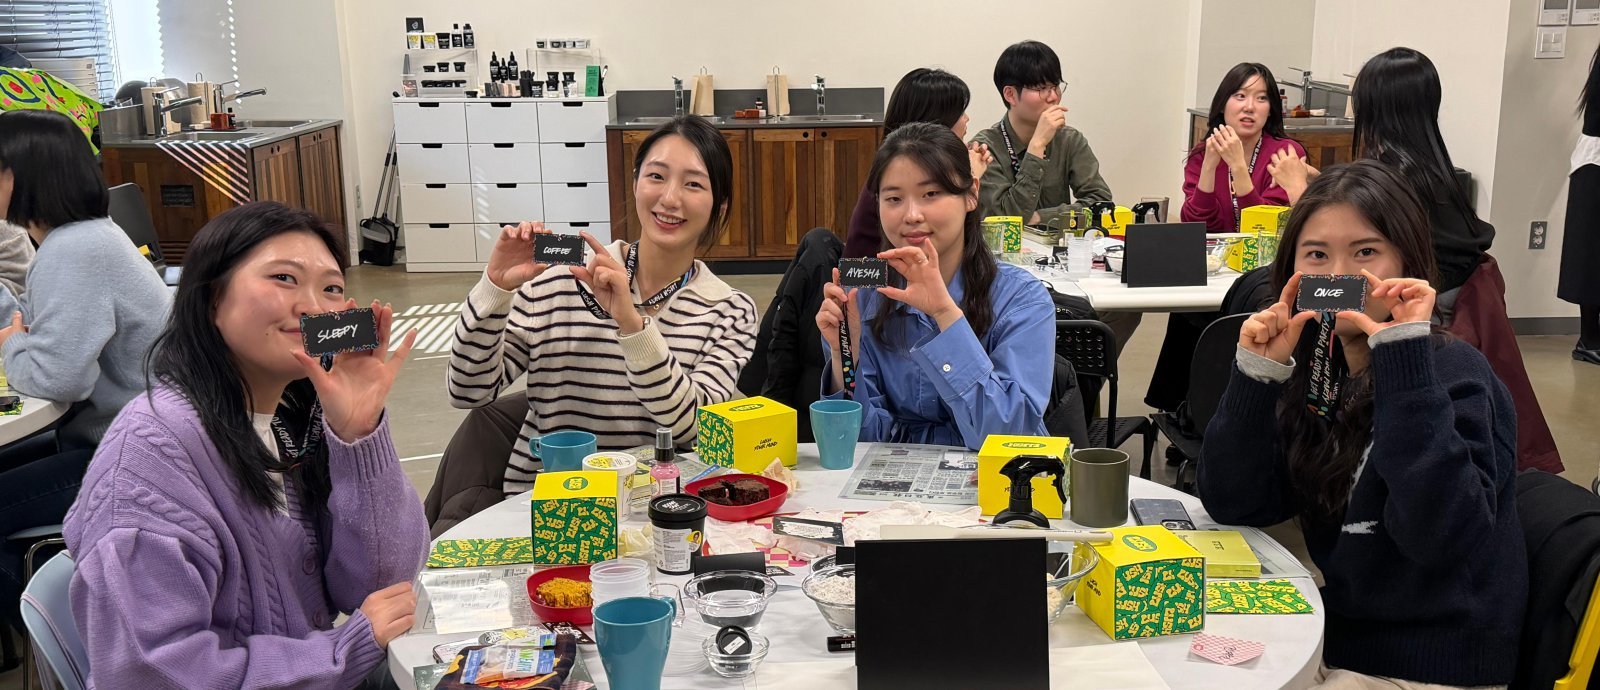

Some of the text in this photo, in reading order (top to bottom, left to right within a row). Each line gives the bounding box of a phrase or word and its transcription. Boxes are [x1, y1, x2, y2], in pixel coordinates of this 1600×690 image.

[543, 246, 572, 255] COFFEE
[1314, 288, 1344, 298] ONCE
[317, 324, 358, 344] SLEEPY
[1318, 319, 1330, 348] PARTY
[1314, 349, 1324, 358] TO
[1312, 357, 1322, 382] READY
